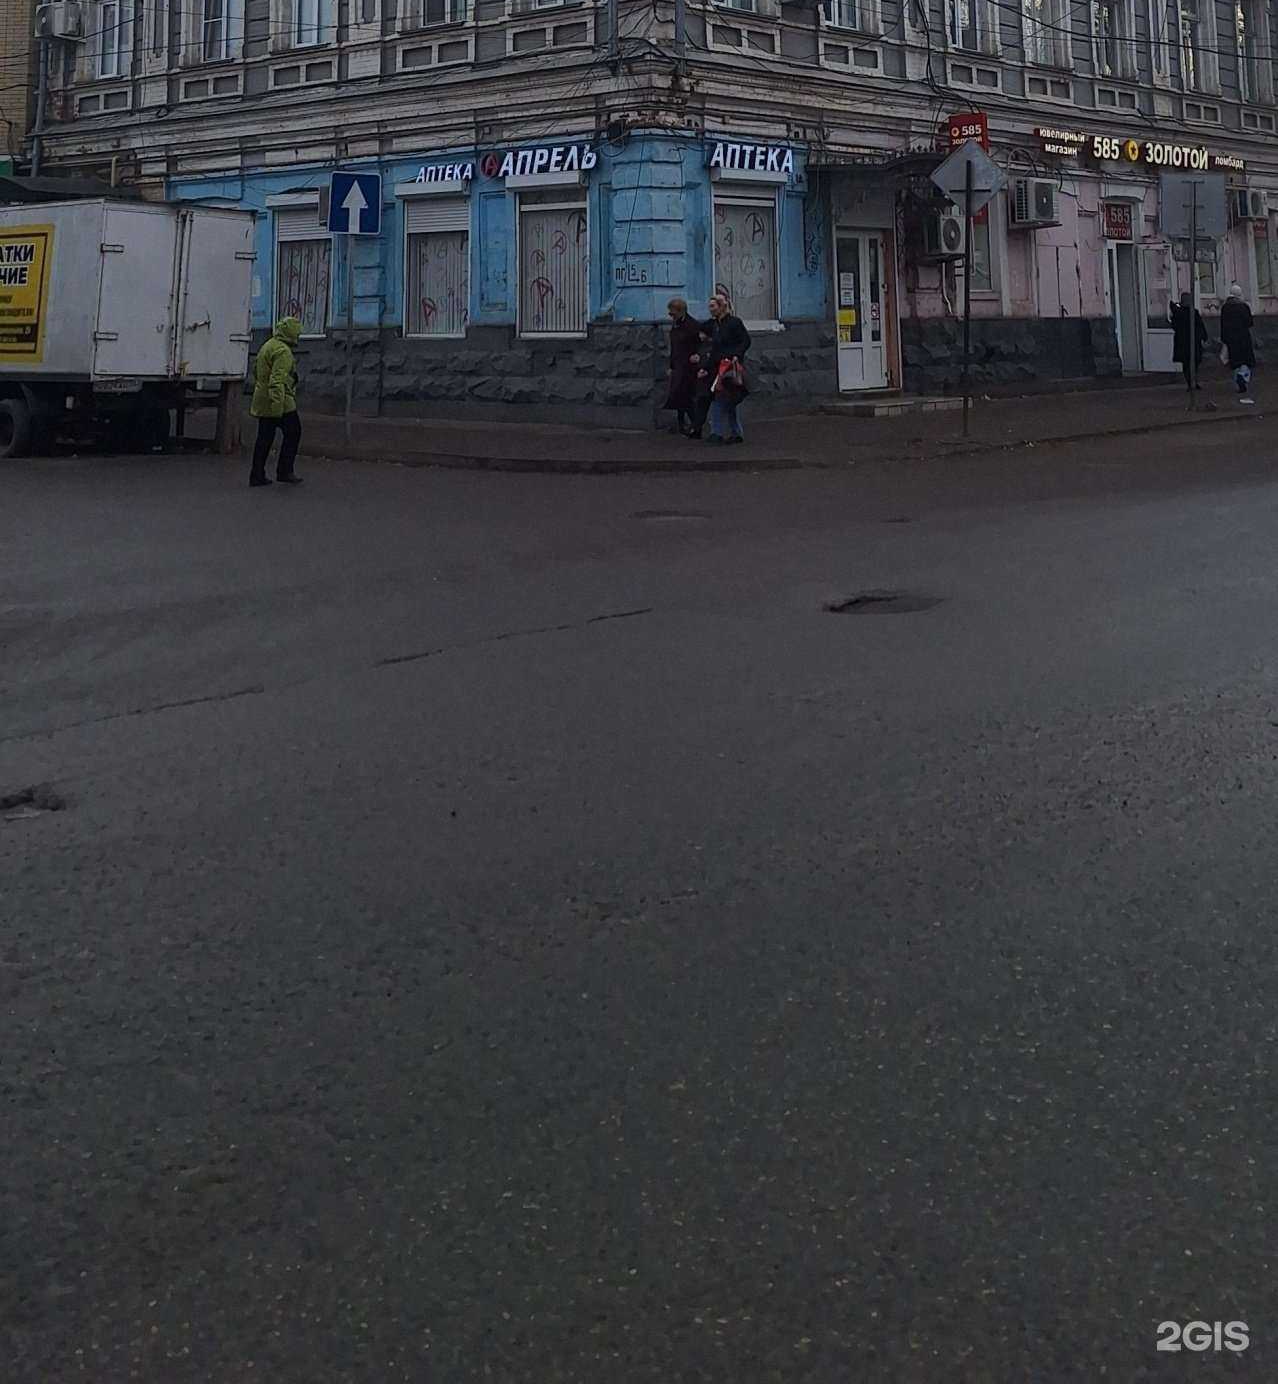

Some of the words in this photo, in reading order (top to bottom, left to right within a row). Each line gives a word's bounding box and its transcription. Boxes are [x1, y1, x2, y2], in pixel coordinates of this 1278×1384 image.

[962, 124, 982, 136] 585
[1040, 128, 1085, 142] ювелирный
[710, 142, 793, 173] АПТЕКА
[1045, 143, 1077, 155] магазин
[1093, 136, 1119, 159] 585
[1145, 142, 1208, 169] ЗОЛОТОЙ
[1215, 156, 1244, 169] ломбард
[500, 144, 597, 176] АПРЕЛЬ
[416, 163, 472, 183] АПТЕКА
[1110, 207, 1130, 224] 585
